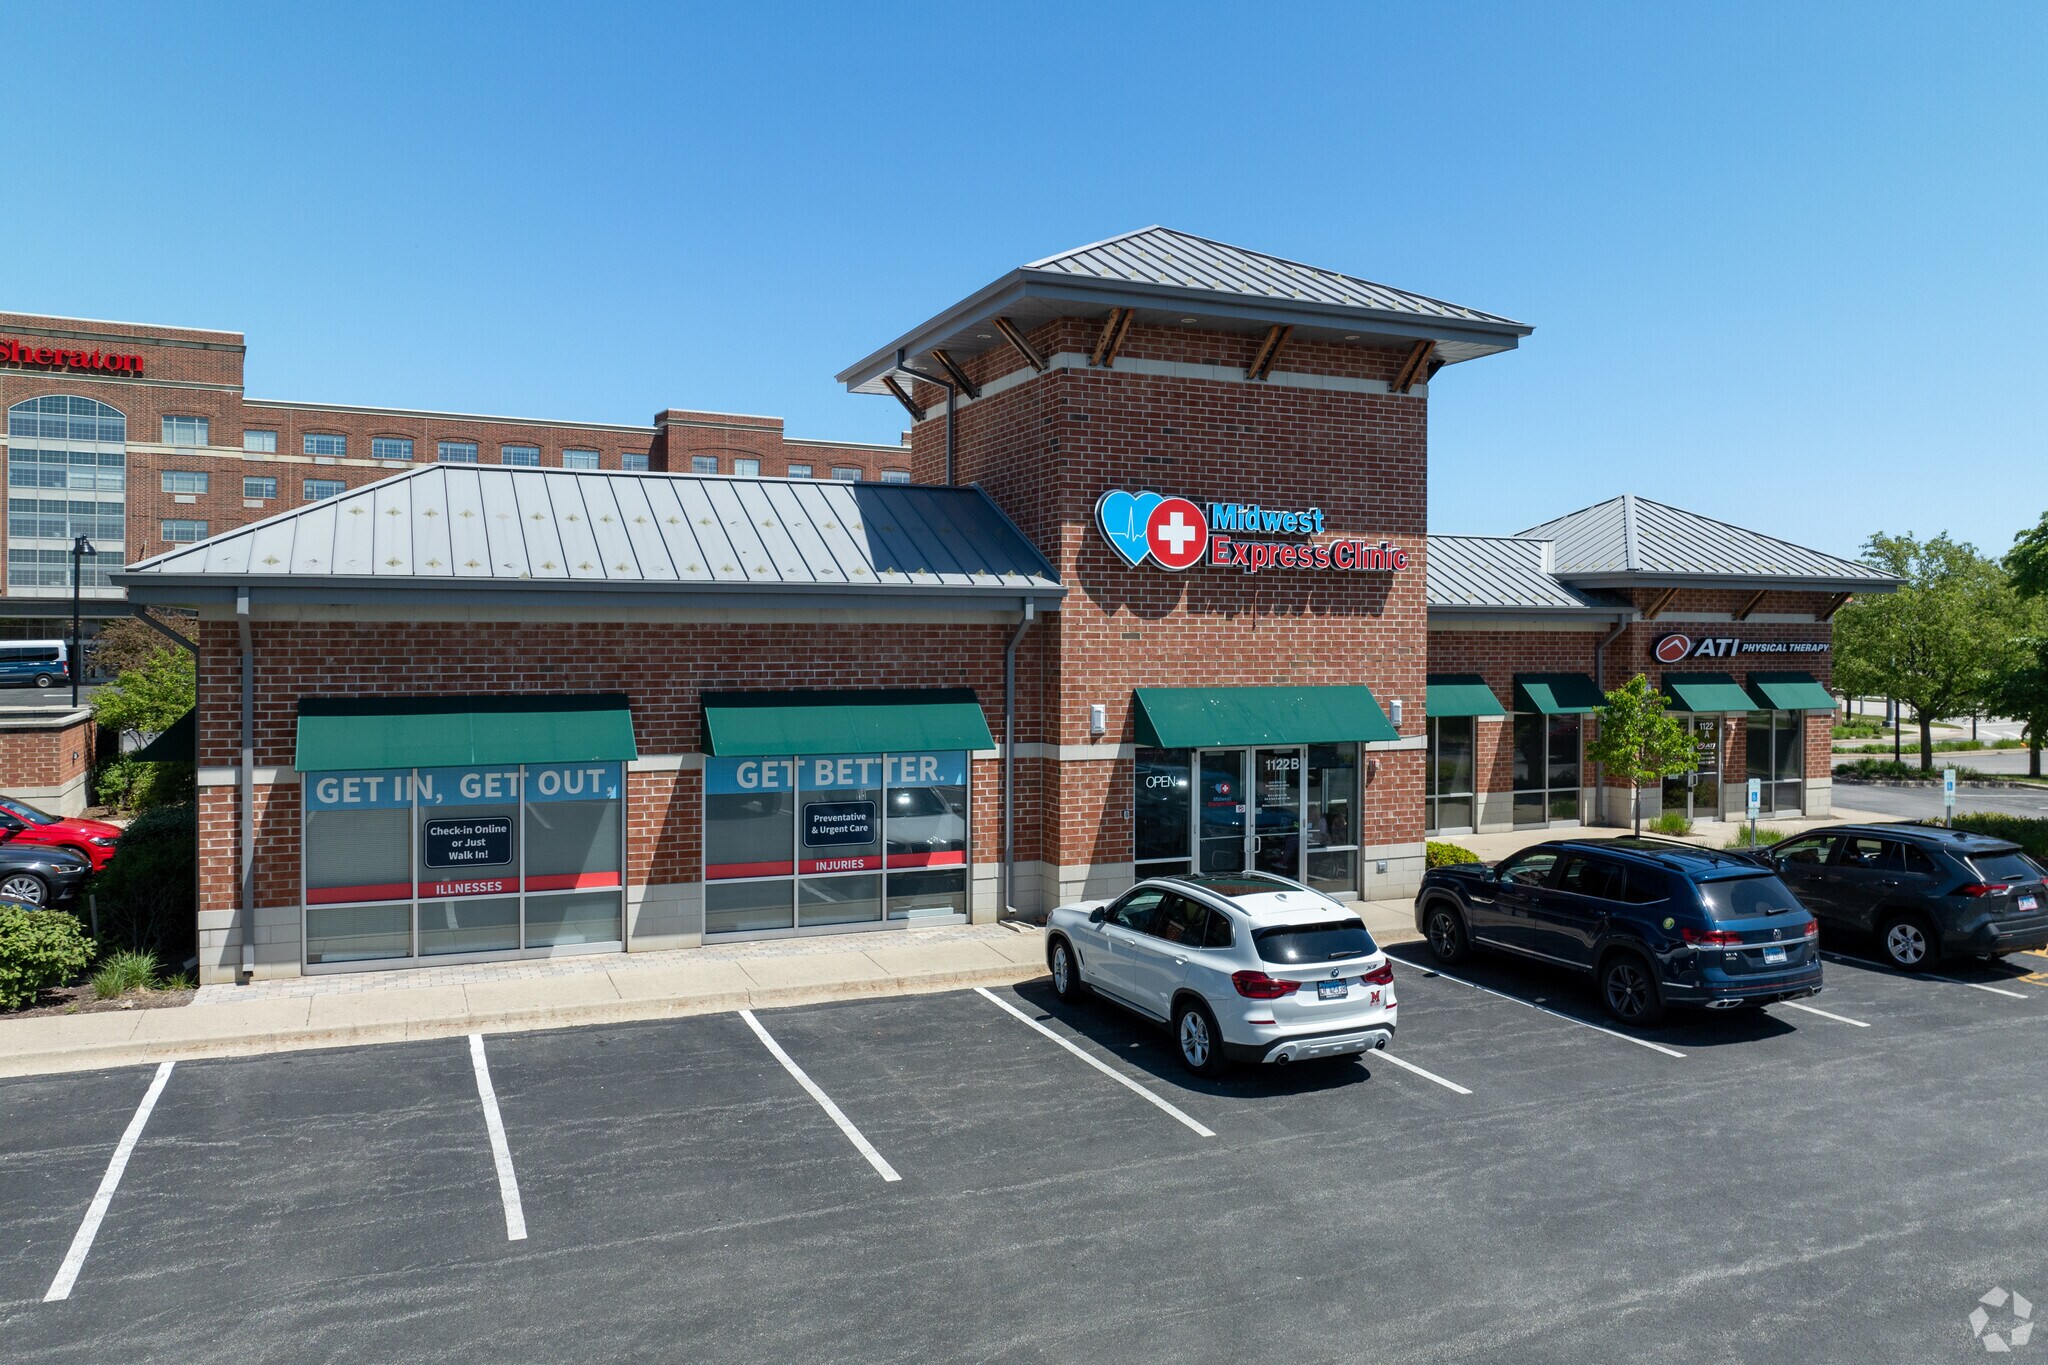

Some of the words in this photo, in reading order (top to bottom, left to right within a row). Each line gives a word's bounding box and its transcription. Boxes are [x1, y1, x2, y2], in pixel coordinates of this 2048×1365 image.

[1212, 503, 1325, 534] Midwest
[1212, 535, 1330, 572] Express
[1334, 540, 1409, 571] Clinic
[1694, 639, 1740, 657] ATI
[1742, 643, 1787, 652] PHYSICAL
[1789, 643, 1829, 652] THERAPY
[1699, 722, 1714, 730] 1122
[736, 759, 805, 788] GET
[815, 756, 945, 786] BETTER.
[316, 776, 384, 804] GET
[394, 773, 443, 805] IN,
[459, 771, 530, 799] GET
[538, 768, 615, 799] OUT,
[1146, 776, 1175, 788] OPEN
[814, 812, 866, 823] Preventative
[430, 823, 472, 837] Check-in
[474, 823, 507, 835] Online
[819, 824, 848, 835] Urgent
[849, 823, 868, 833] Care
[451, 839, 462, 848] or
[464, 837, 486, 848] Just
[448, 850, 472, 861] Walk
[474, 850, 488, 860] In!
[816, 859, 864, 871] INJURIES
[436, 881, 502, 895] ILLNESSES
